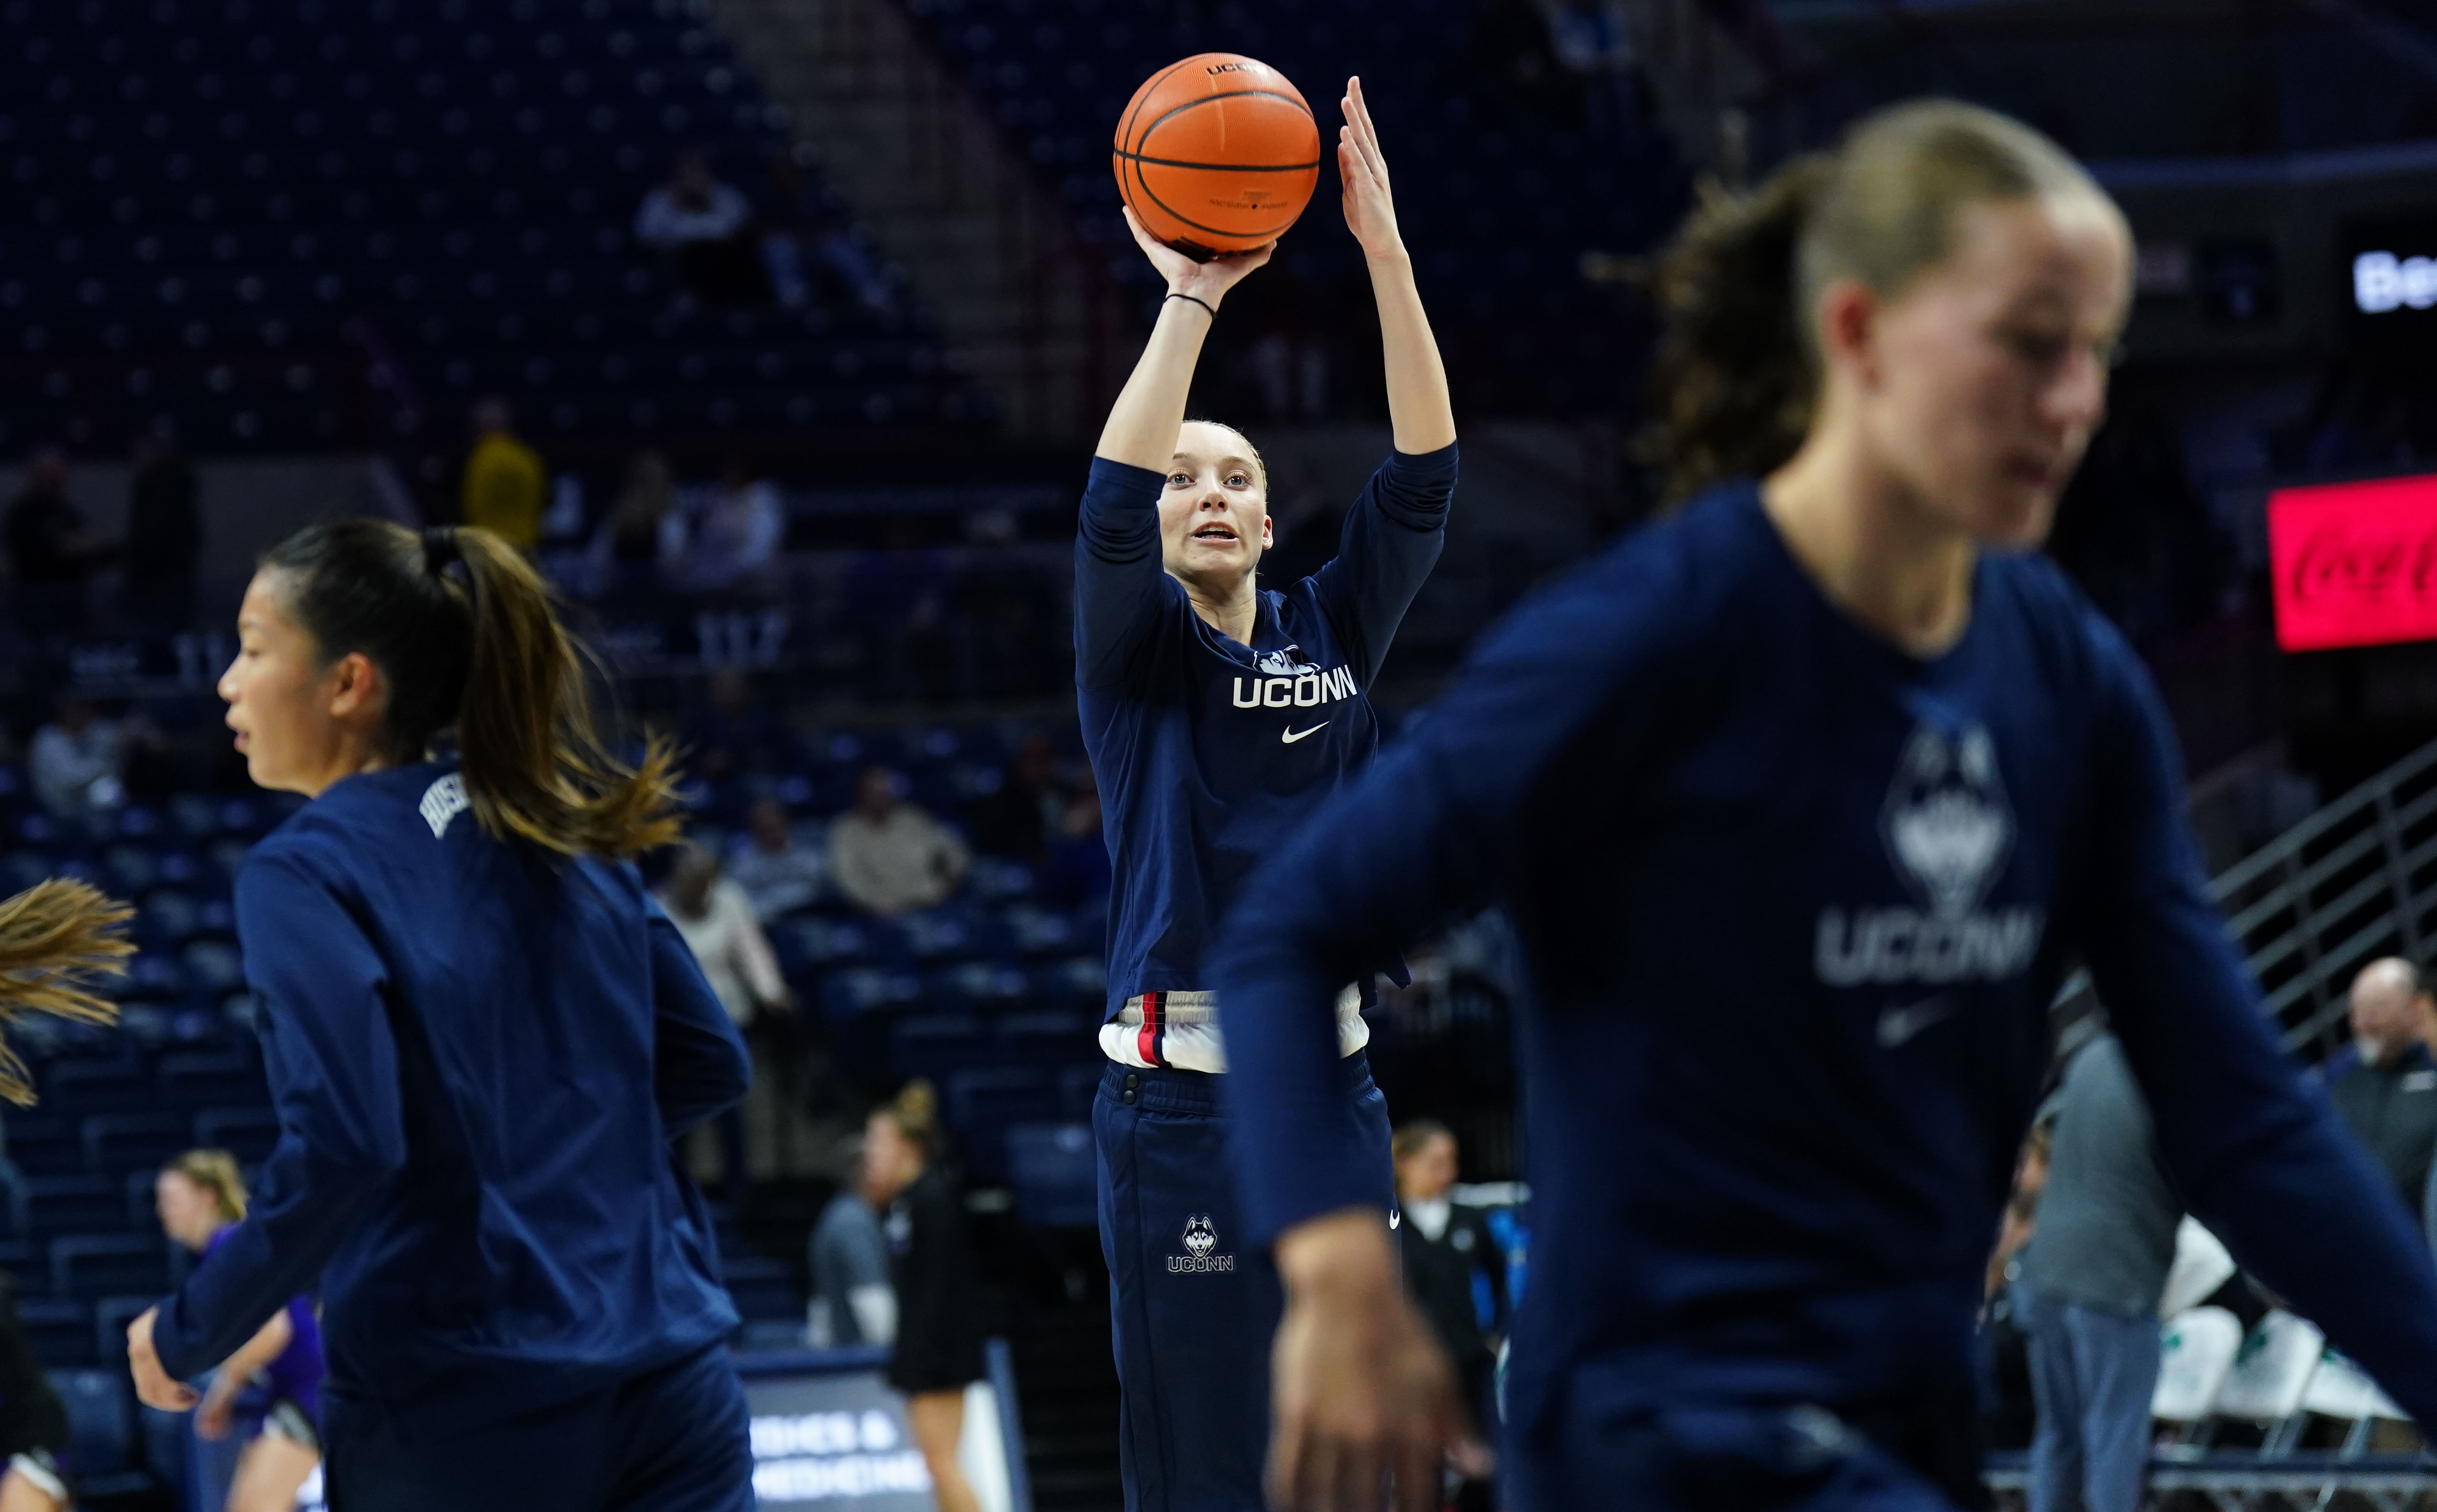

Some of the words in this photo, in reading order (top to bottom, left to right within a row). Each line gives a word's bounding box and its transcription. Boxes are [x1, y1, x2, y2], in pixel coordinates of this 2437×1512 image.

[1233, 665, 1358, 709] UCONN
[1814, 903, 2046, 987] UCONN
[1167, 1255, 1234, 1273] UCONN
